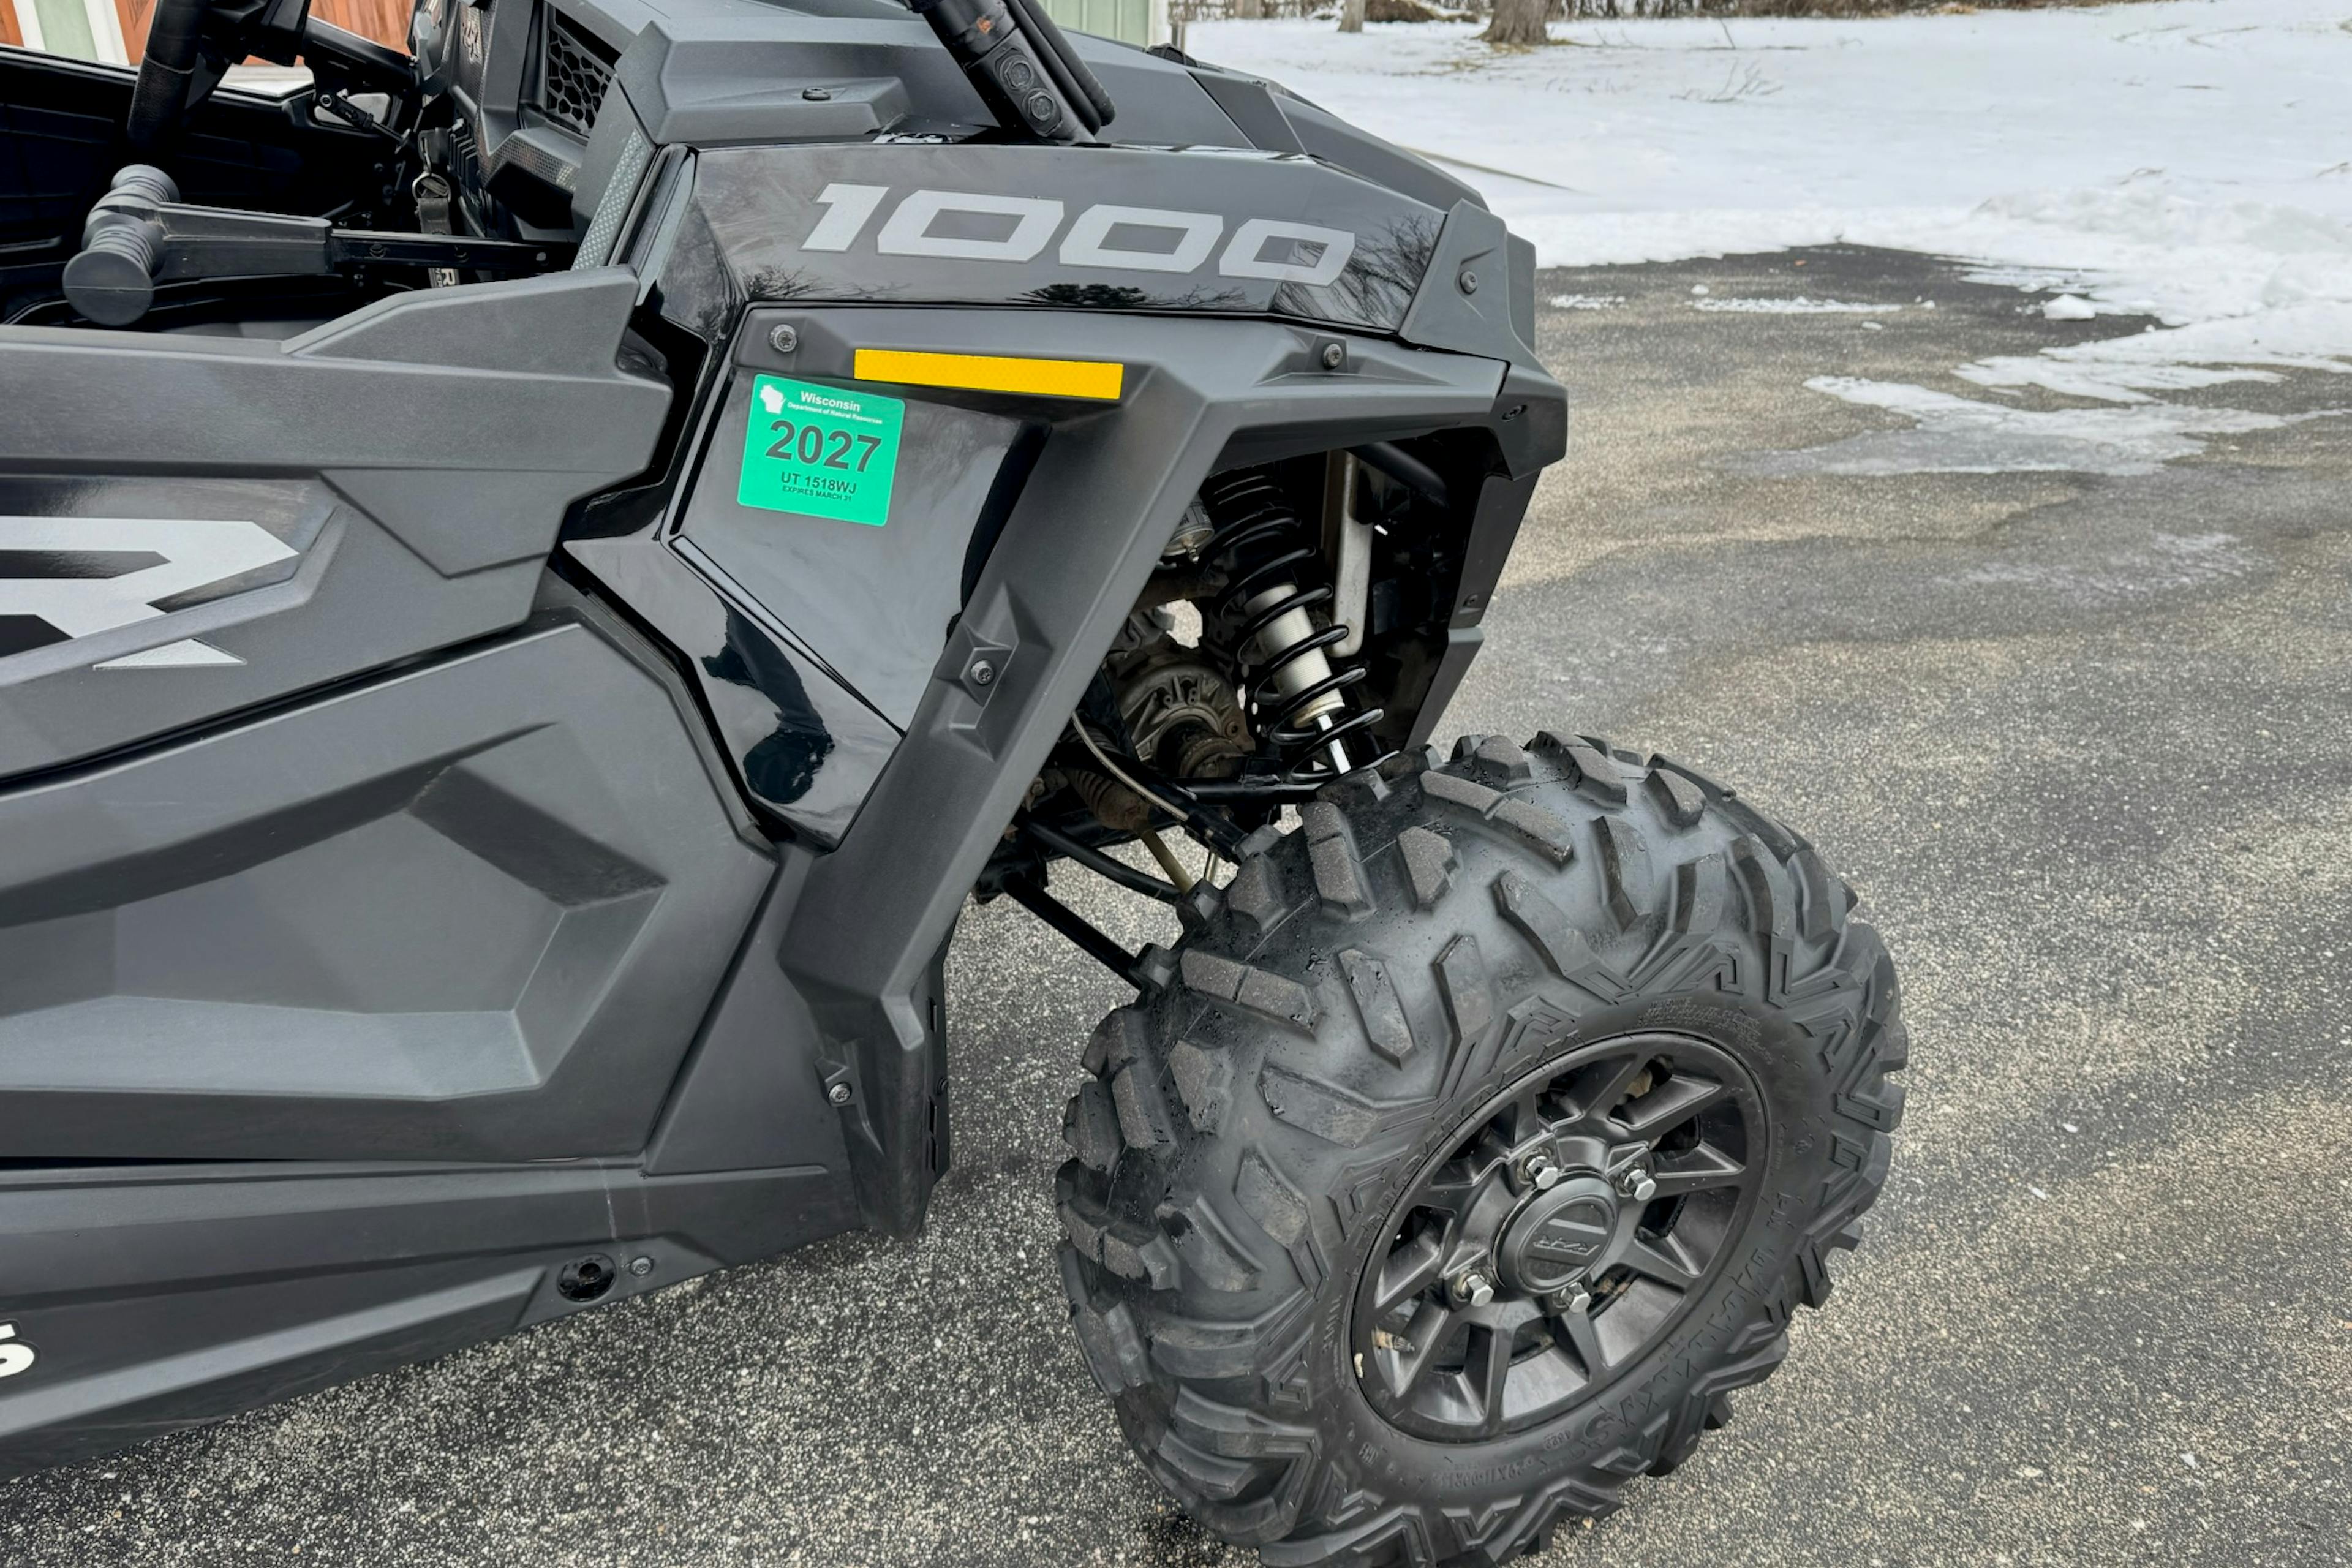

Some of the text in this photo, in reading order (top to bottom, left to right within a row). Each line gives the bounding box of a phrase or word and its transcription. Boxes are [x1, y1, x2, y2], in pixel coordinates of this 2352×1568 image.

[800, 183, 1355, 287] 1000
[801, 391, 861, 412] Wisconsin
[787, 402, 823, 414] Department
[829, 410, 851, 419] Natural
[852, 414, 883, 424] Resources
[765, 420, 882, 473] 2027
[782, 471, 857, 494] UT 1518WJ
[782, 484, 813, 496] EXPIRES
[815, 490, 842, 500] MARCH
